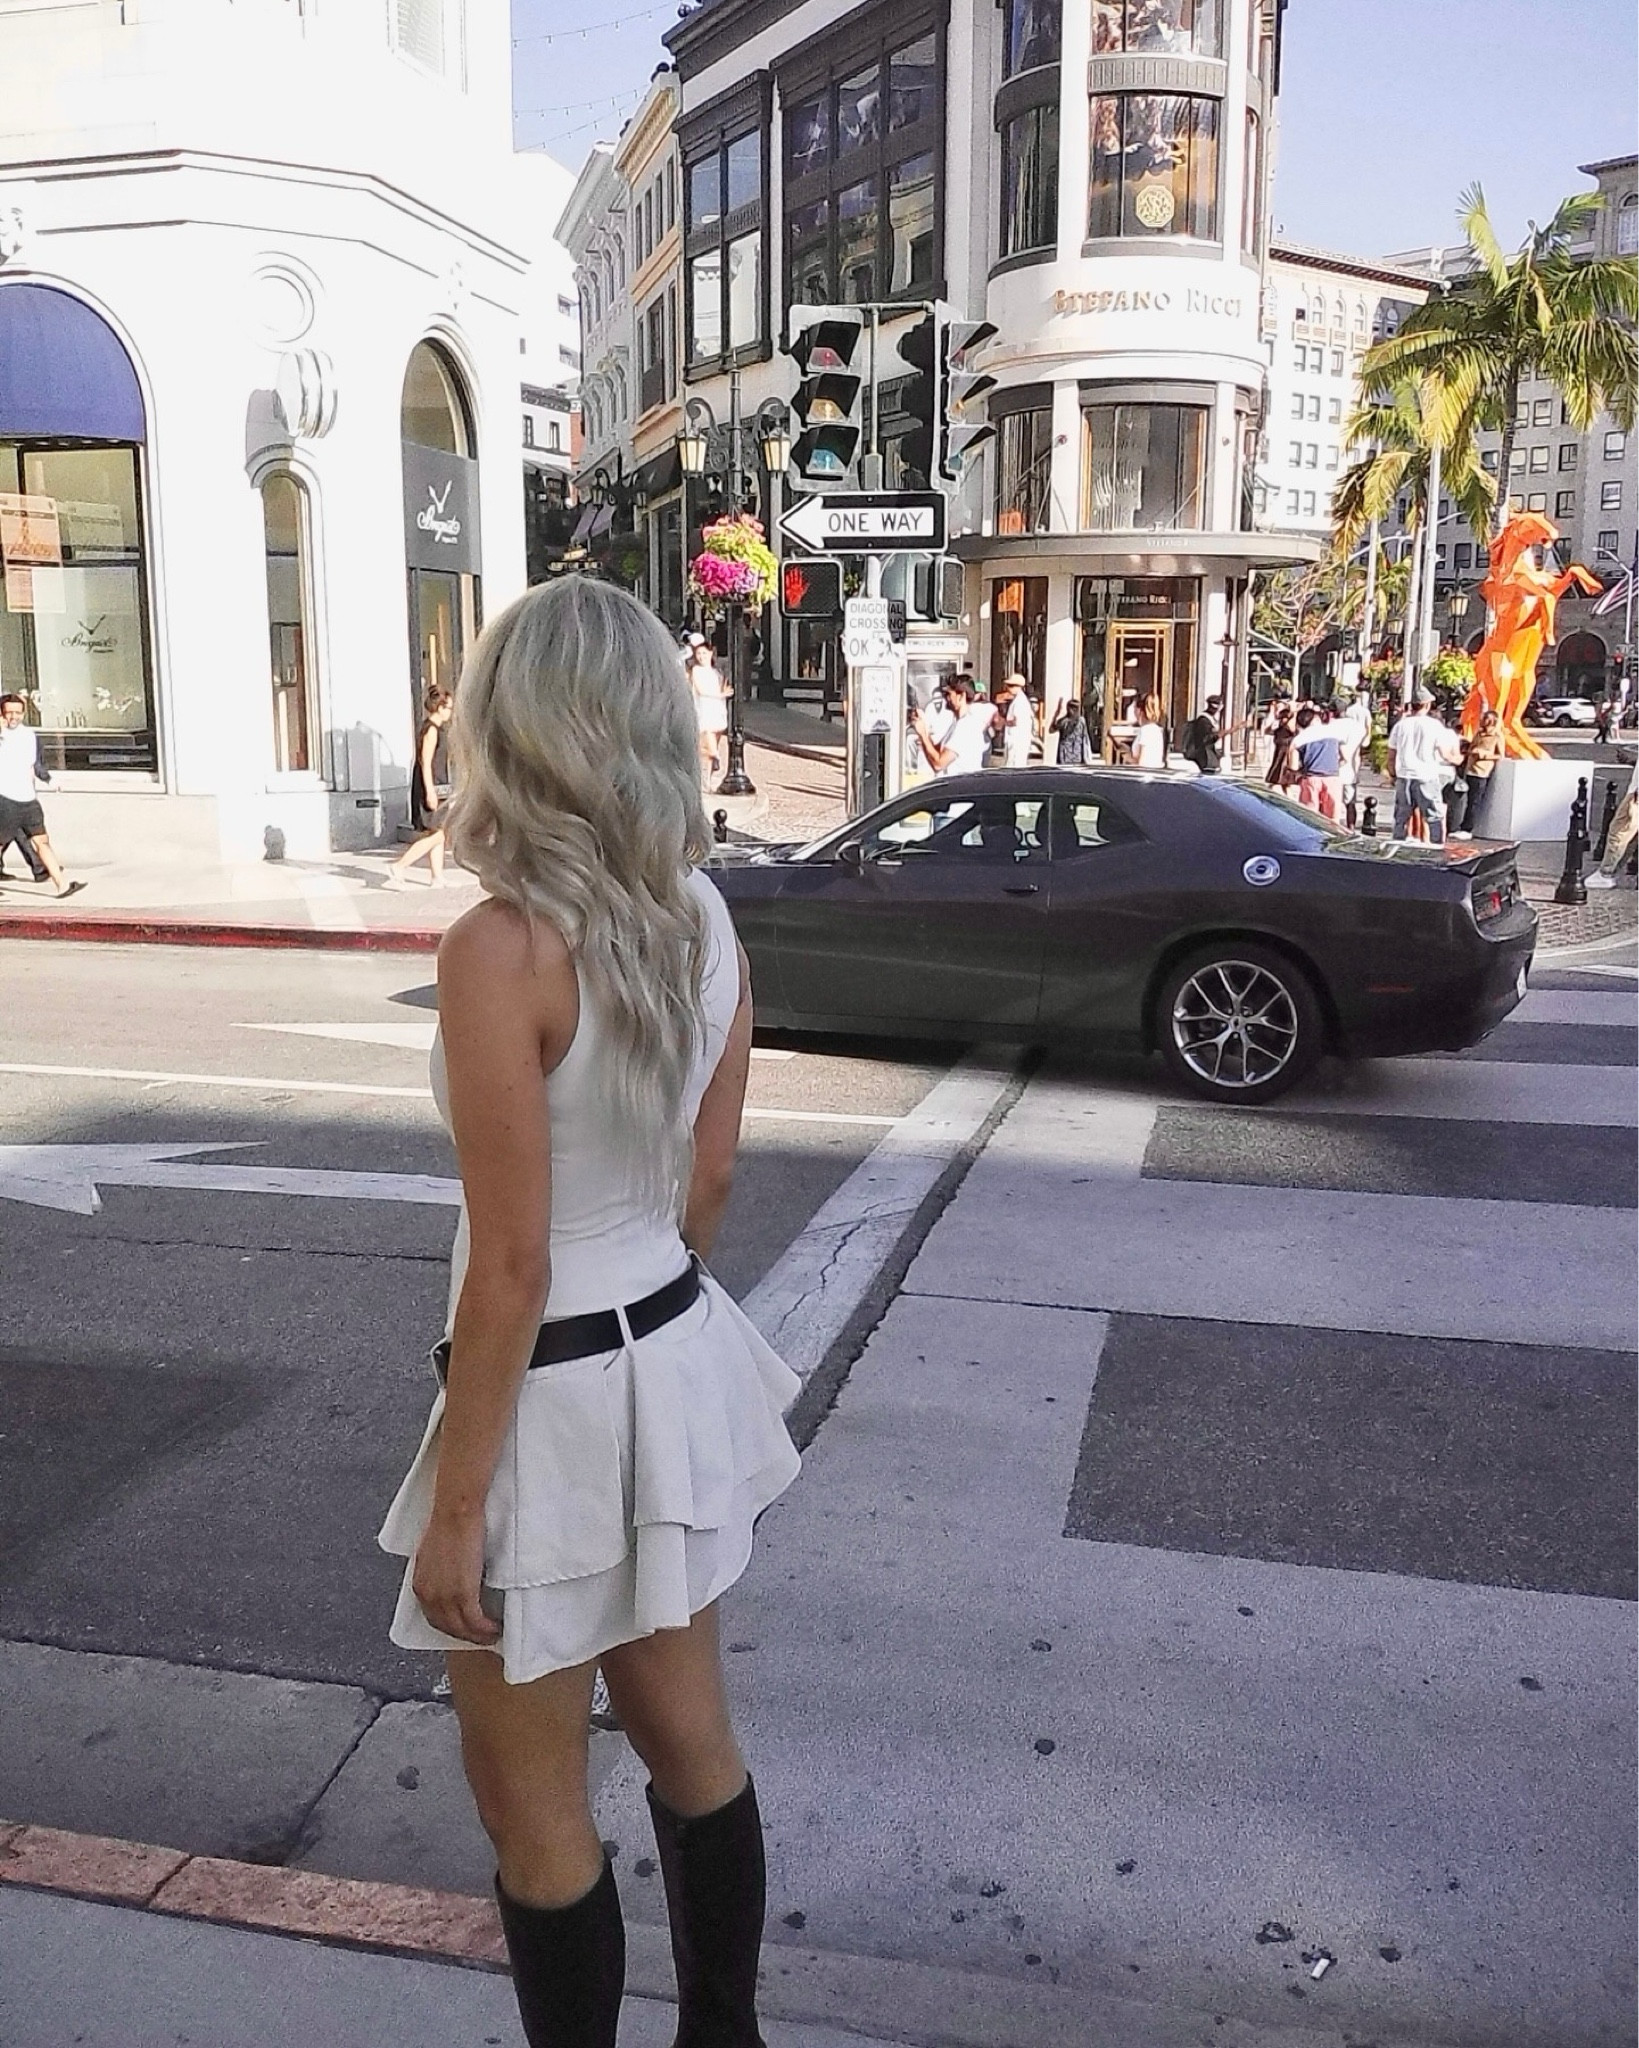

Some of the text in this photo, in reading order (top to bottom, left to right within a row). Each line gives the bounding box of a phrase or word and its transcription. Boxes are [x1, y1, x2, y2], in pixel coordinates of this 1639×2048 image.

[1054, 289, 1171, 316] STEFANO
[828, 511, 923, 532] ONE WAY
[849, 638, 869, 657] OK
